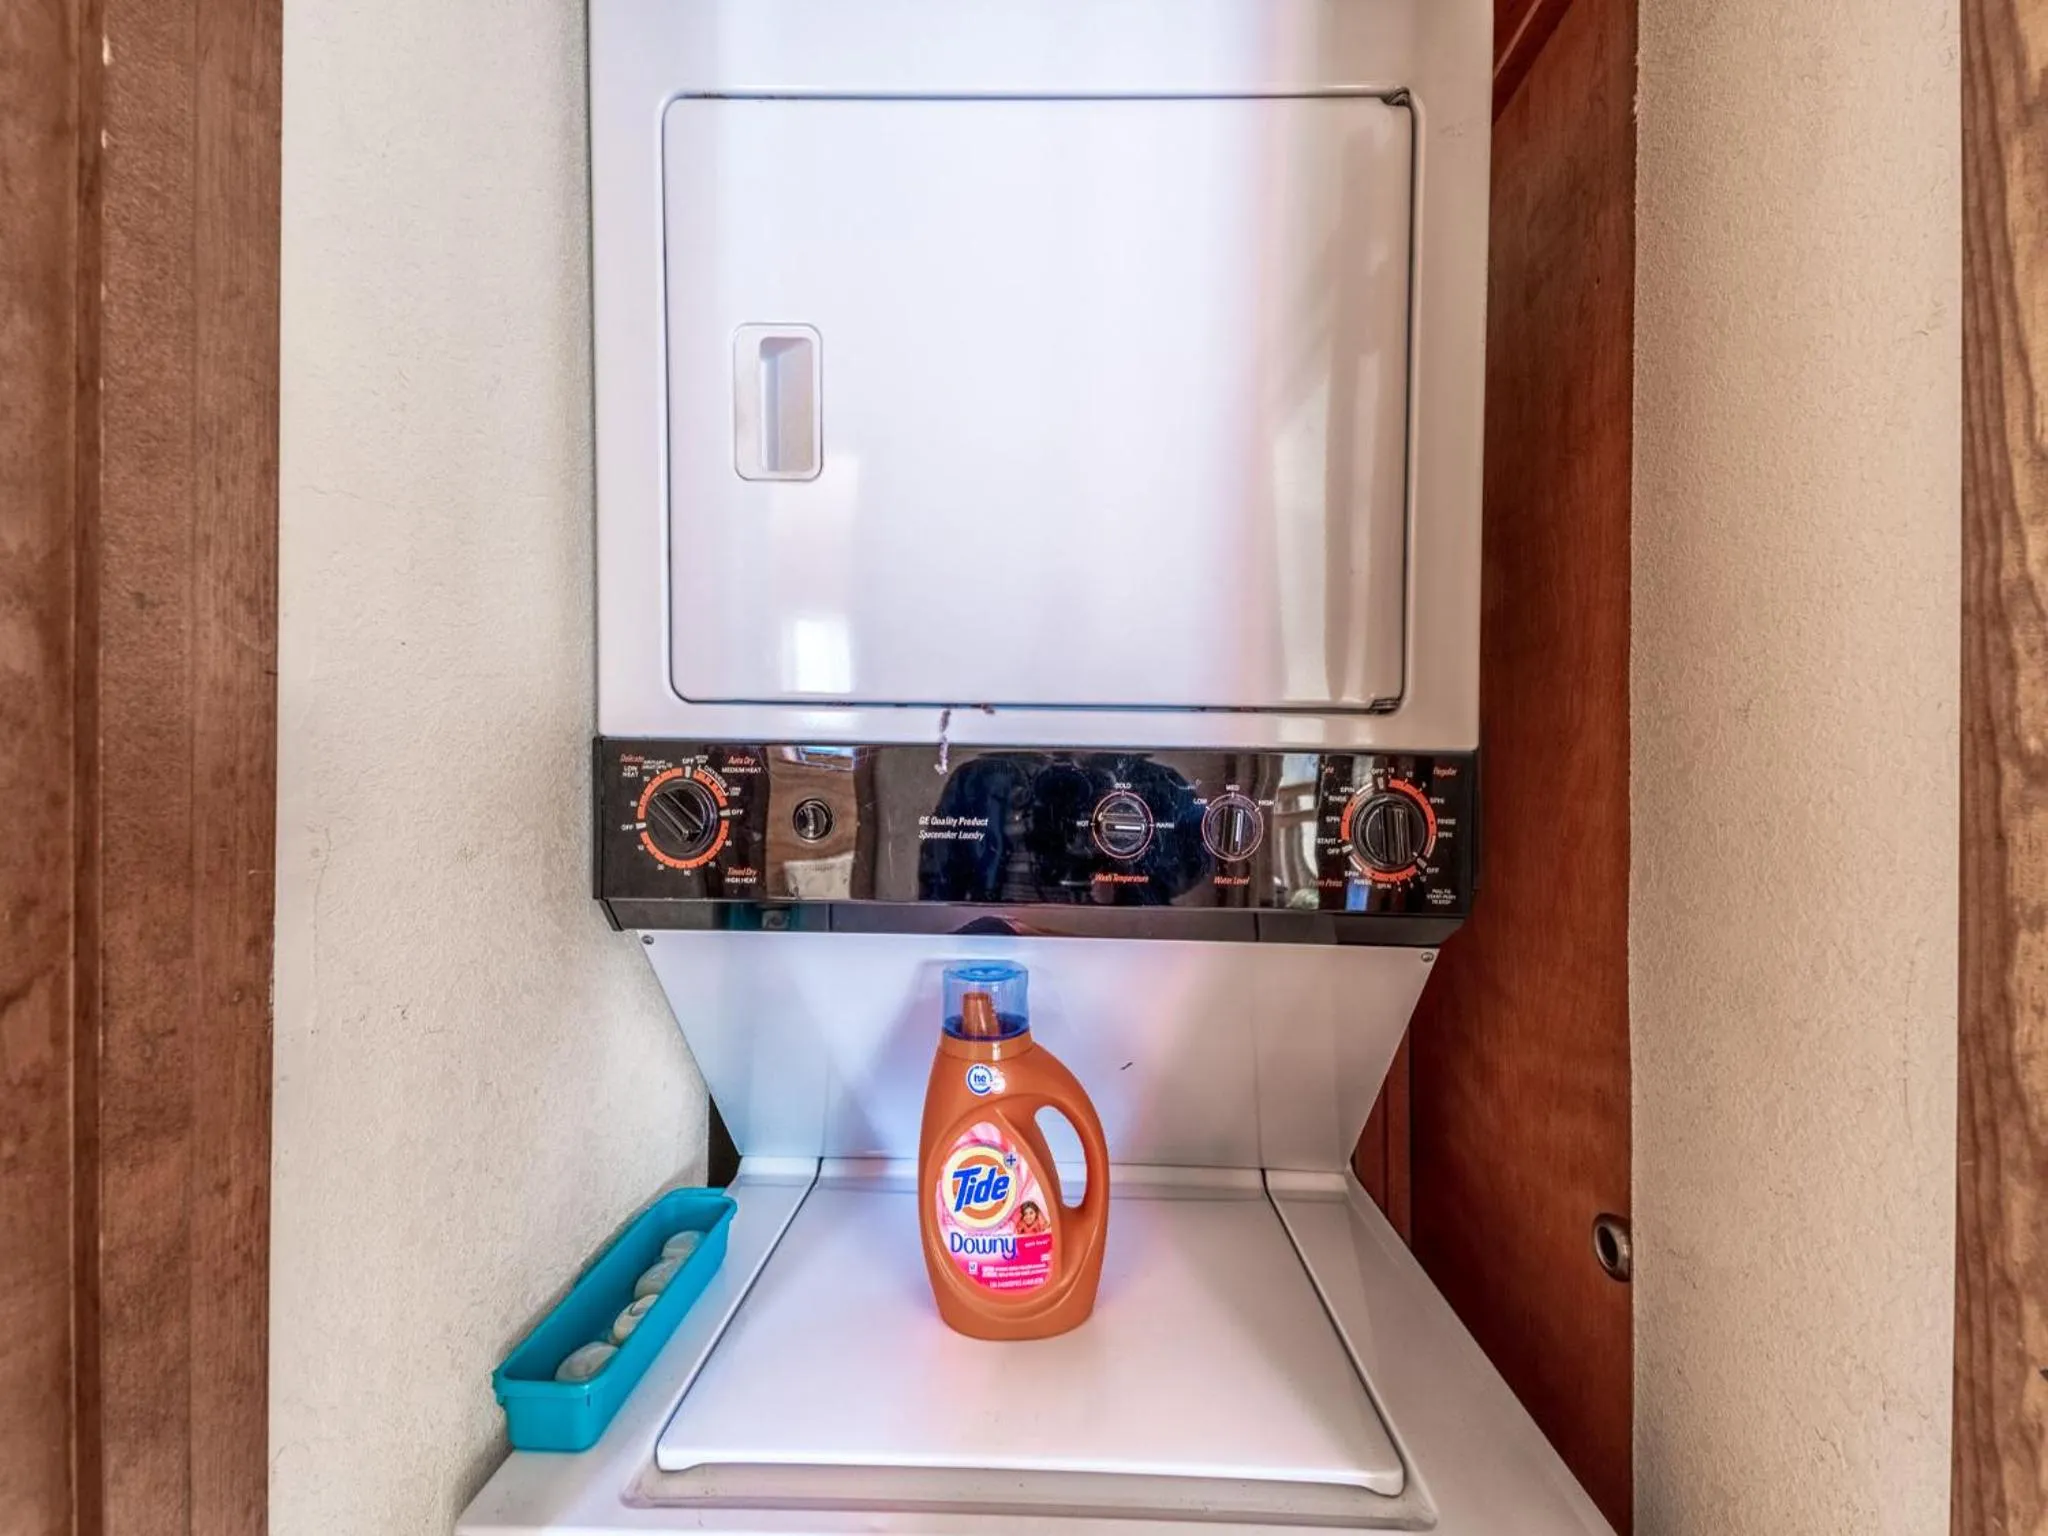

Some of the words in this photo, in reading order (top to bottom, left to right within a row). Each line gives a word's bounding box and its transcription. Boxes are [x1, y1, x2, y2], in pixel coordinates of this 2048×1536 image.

[744, 756, 755, 766] Dry
[1433, 766, 1458, 778] Regular
[731, 808, 743, 816] OFF
[621, 823, 633, 831] OFF
[919, 816, 930, 825] GE
[930, 816, 958, 827] Quality
[958, 816, 989, 826] Product
[1112, 872, 1149, 884] Temperature
[1214, 876, 1232, 885] Water
[1233, 876, 1250, 885] Level
[974, 1072, 987, 1084] he
[952, 1166, 1011, 1213] Tide
[950, 1232, 1018, 1261] Downy
